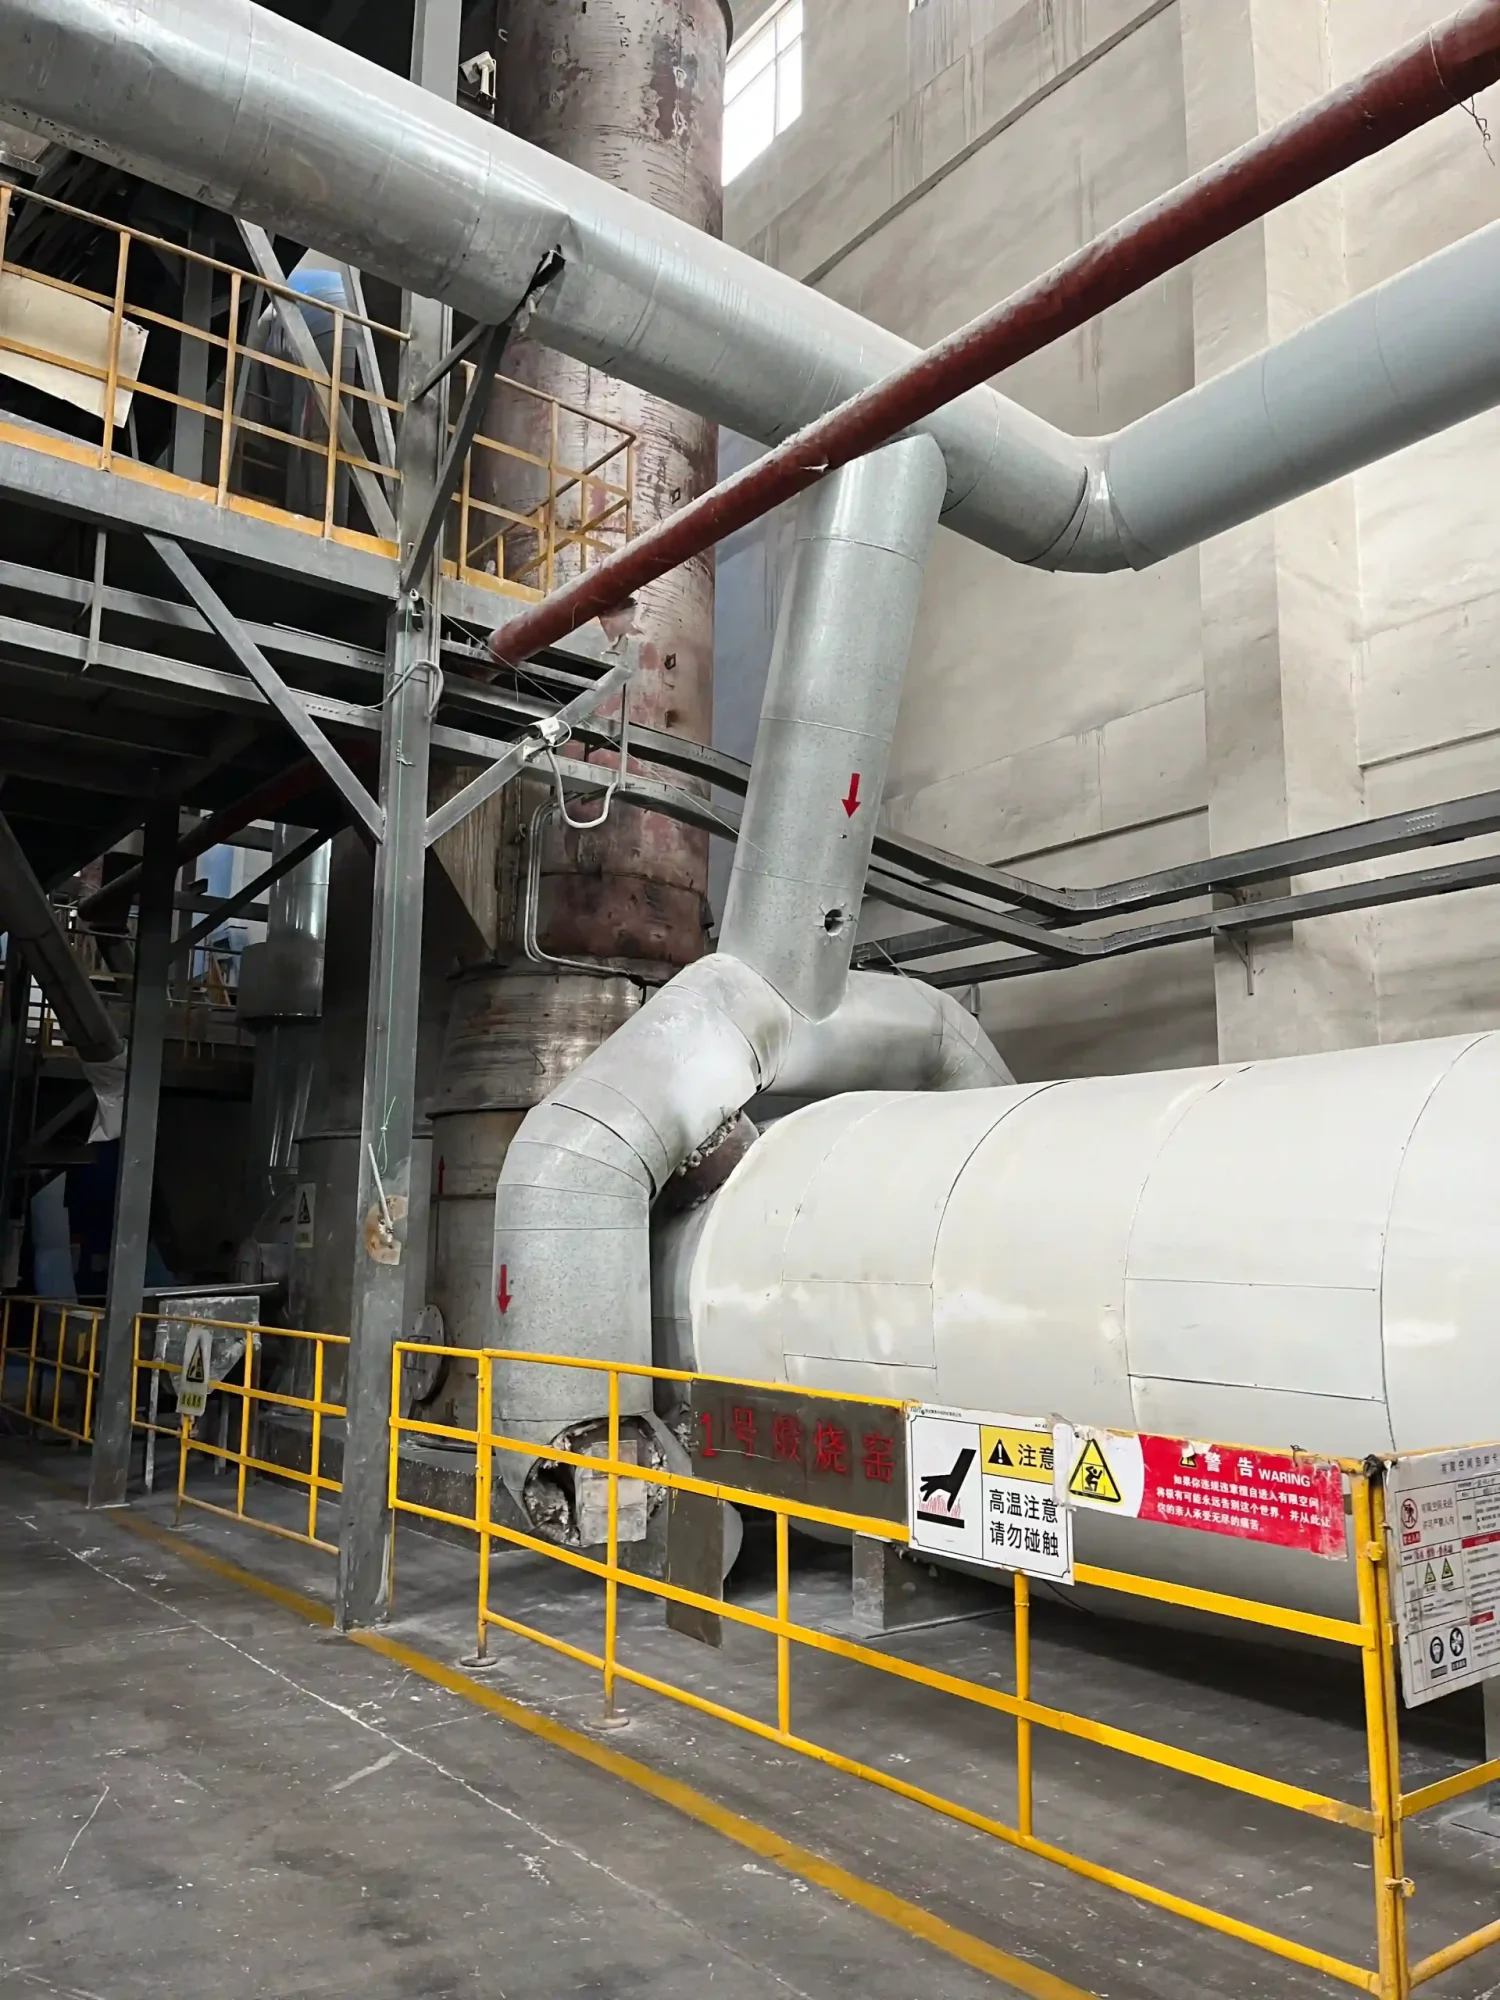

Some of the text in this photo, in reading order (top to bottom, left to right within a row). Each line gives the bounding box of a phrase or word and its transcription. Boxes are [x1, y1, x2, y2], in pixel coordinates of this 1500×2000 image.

[1018, 1443, 1054, 1470] 注意
[1258, 1468, 1311, 1488] WARING
[989, 1489, 1058, 1524] 高温注意
[990, 1520, 1060, 1558] 请勿碰触
